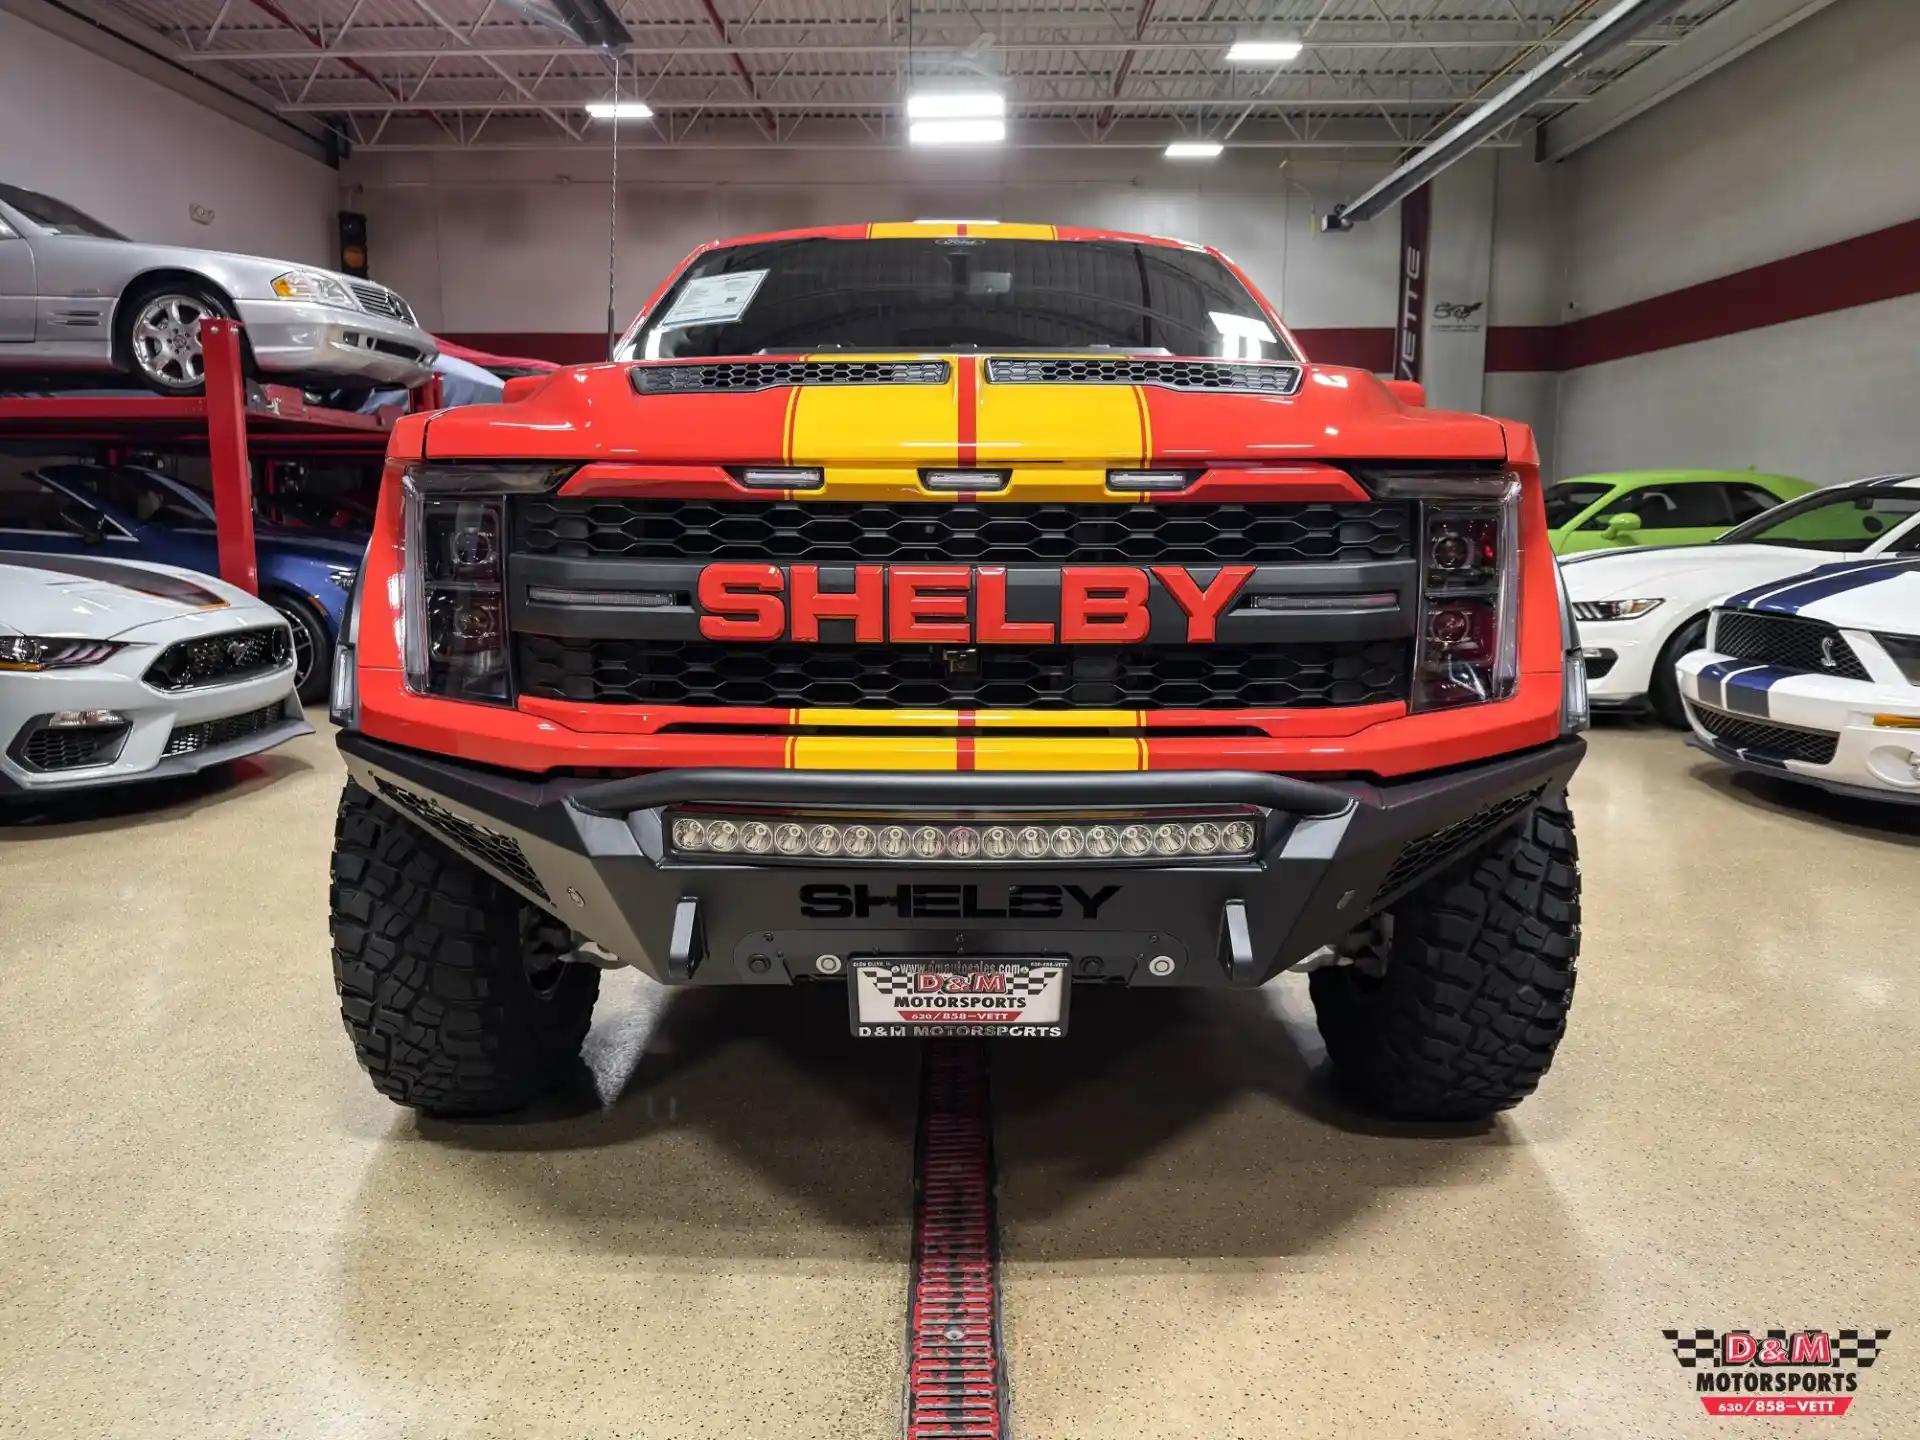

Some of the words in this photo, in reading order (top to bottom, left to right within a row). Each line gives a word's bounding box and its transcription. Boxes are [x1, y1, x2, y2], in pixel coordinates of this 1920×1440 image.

[697, 563, 1257, 643] SHELBY
[799, 883, 1123, 919] SHELBY
[913, 974, 1006, 993] D&M
[894, 997, 1026, 1008] MOTORSPORTS
[859, 1026, 906, 1037] D&M
[913, 1025, 1062, 1037] MOTORSPORTS
